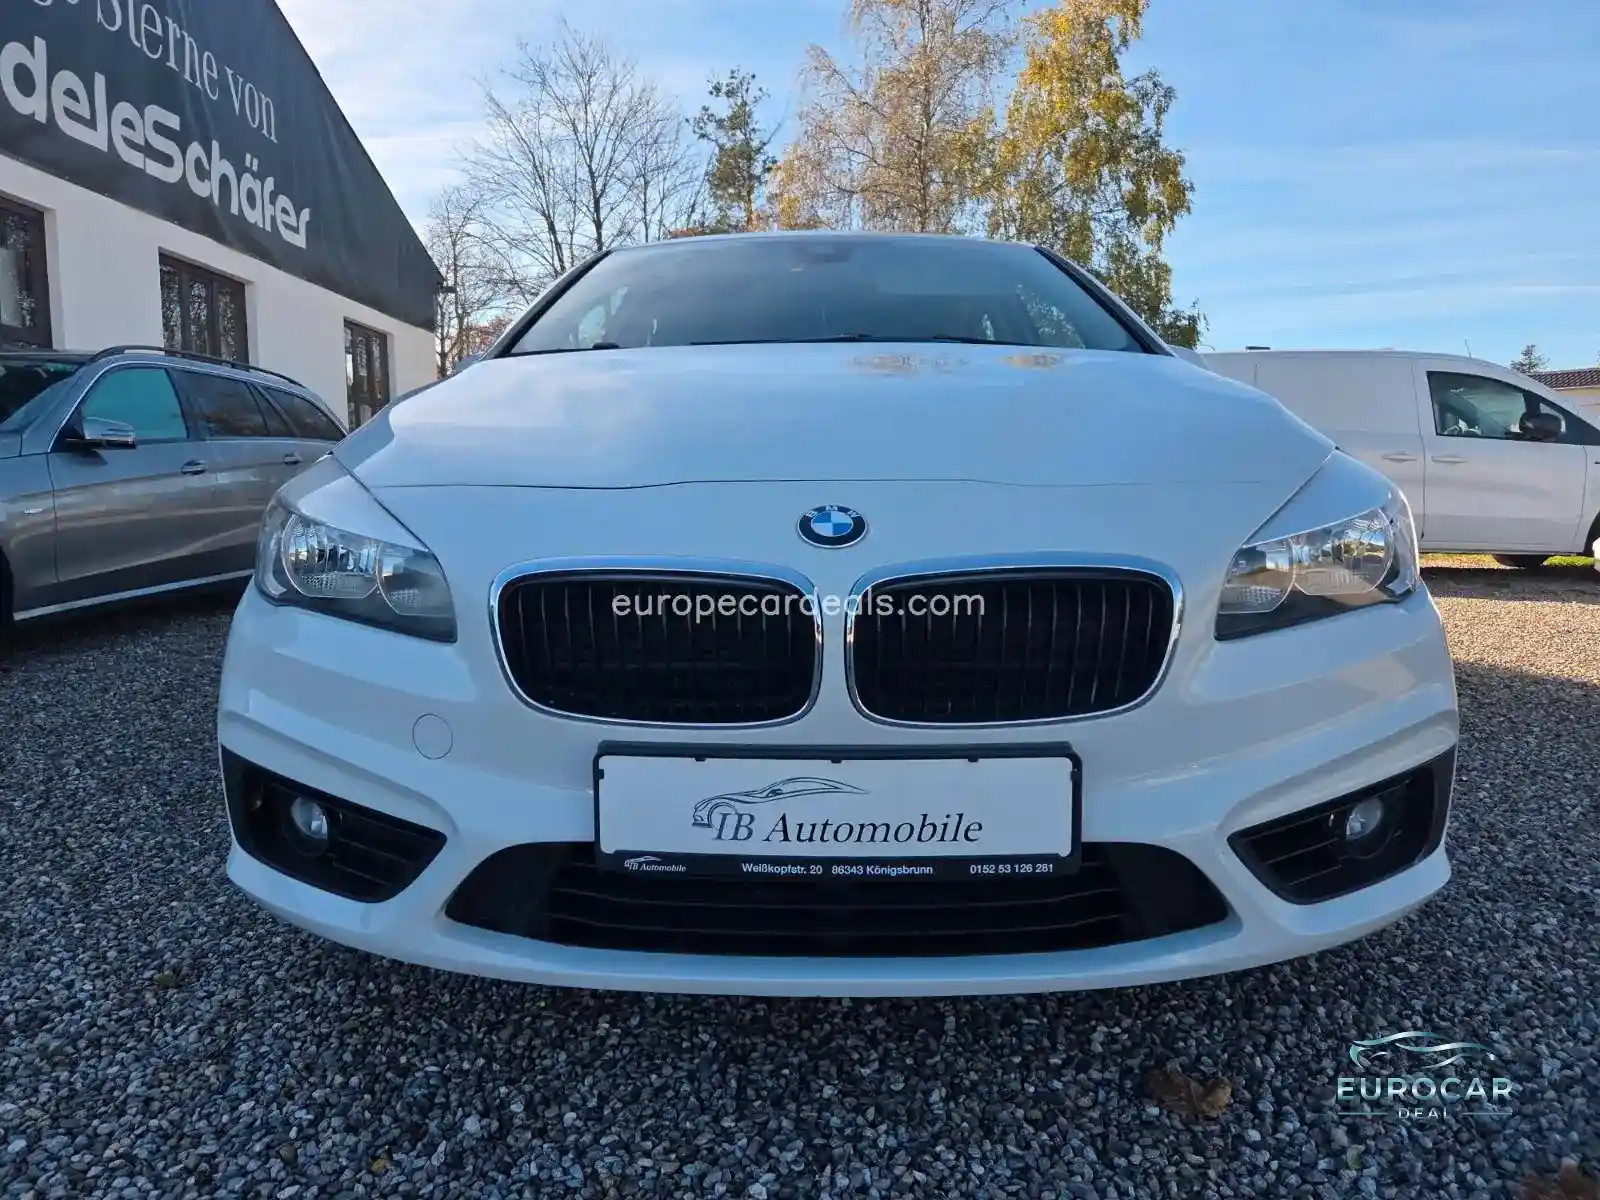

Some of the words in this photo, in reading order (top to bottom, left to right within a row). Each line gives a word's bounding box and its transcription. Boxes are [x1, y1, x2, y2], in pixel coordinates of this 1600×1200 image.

[225, 65, 278, 143] von
[805, 505, 861, 518] BMW
[711, 811, 755, 841] IB
[762, 811, 983, 843] Automobile
[640, 863, 687, 873] Automobile
[741, 862, 807, 876] Weißkopfstr.
[809, 864, 823, 875] 20
[831, 865, 864, 875] 86343
[866, 864, 934, 877] Königsbrunn
[969, 864, 996, 874] 0152
[998, 864, 1011, 874] 53
[1014, 863, 1033, 873] 126
[1035, 862, 1054, 873] 281
